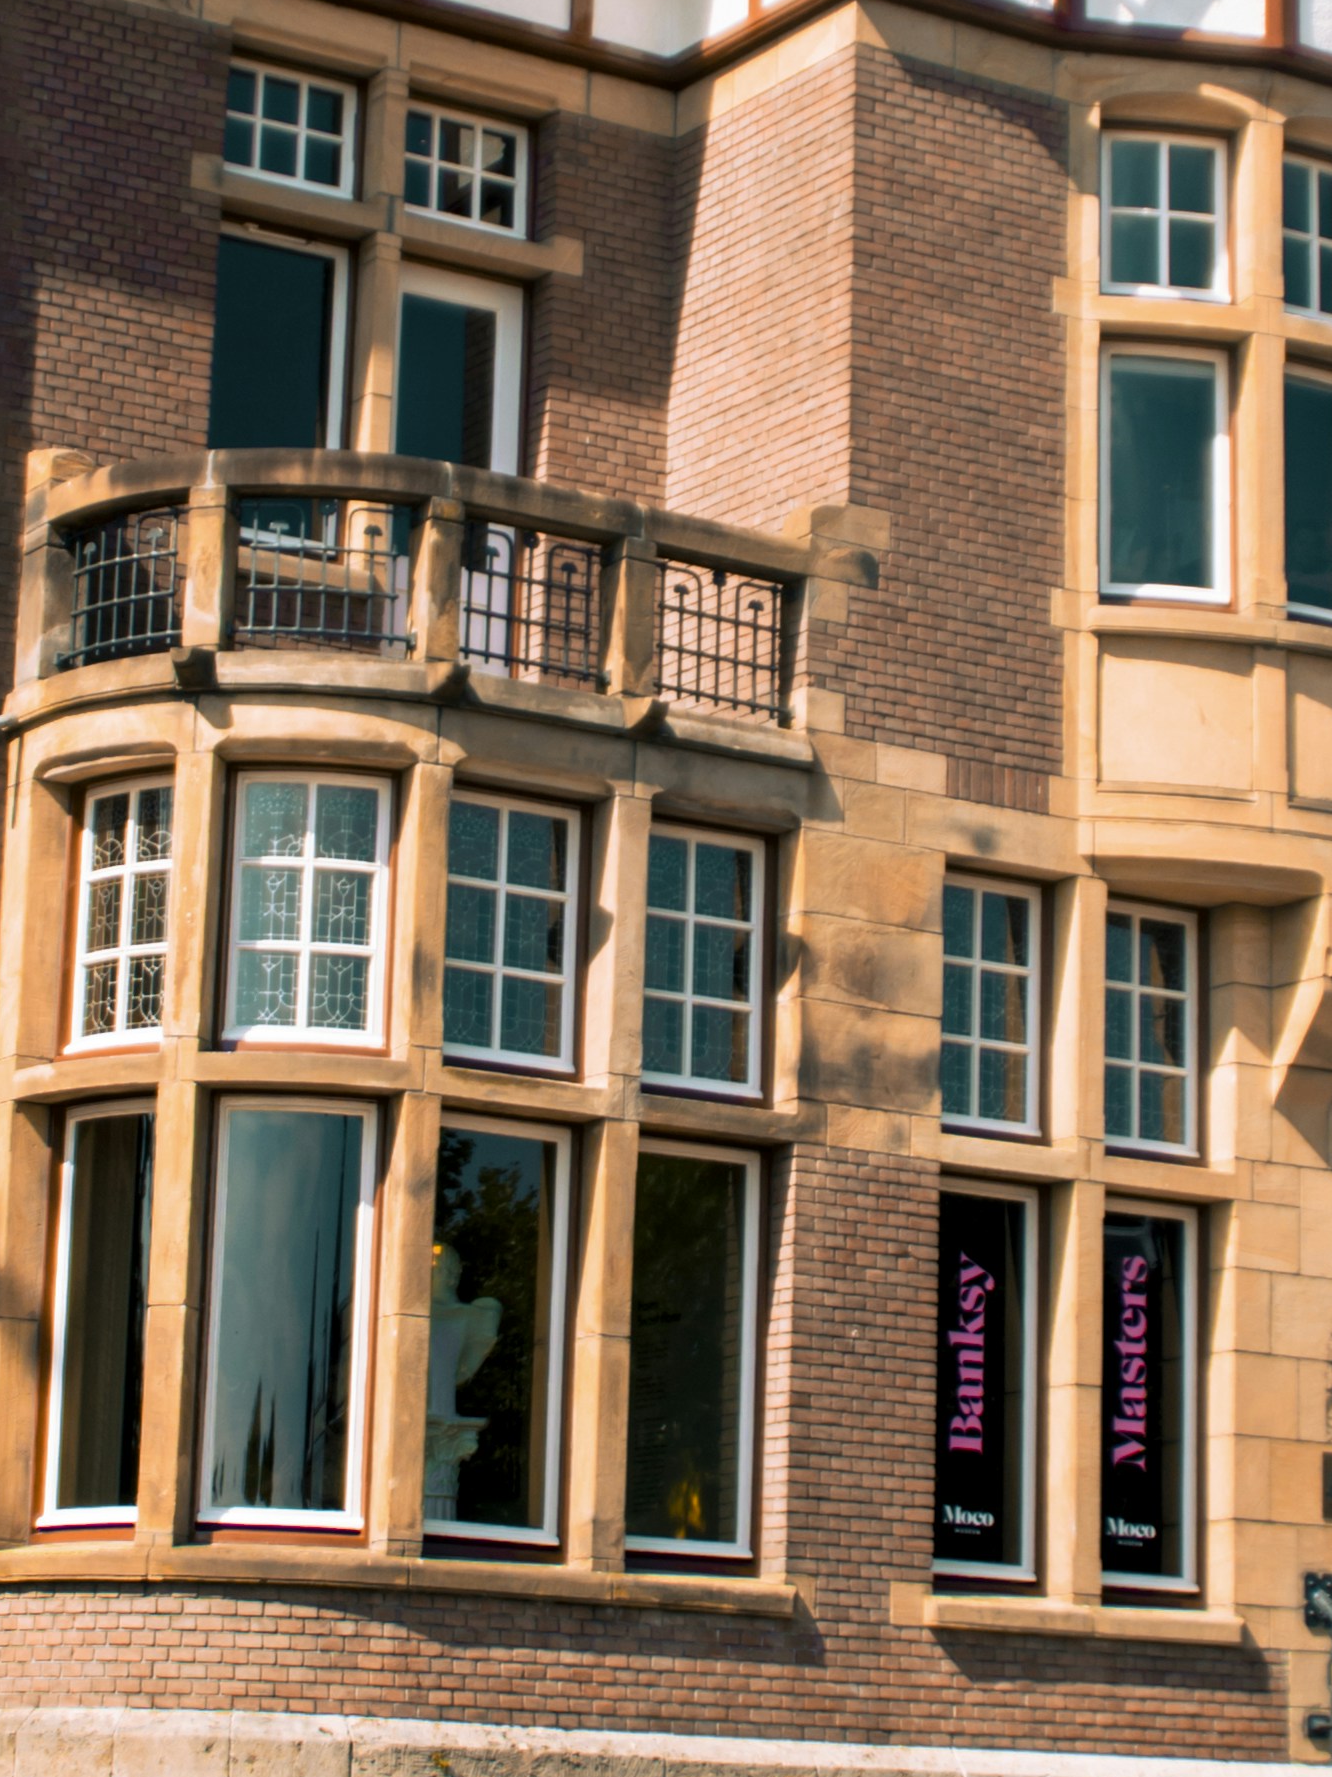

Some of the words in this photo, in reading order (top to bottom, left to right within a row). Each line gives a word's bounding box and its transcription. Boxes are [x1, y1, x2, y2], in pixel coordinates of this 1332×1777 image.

[947, 1250, 995, 1455] Banksy
[1111, 1254, 1150, 1473] Masters
[943, 1504, 995, 1527] Moco
[1106, 1516, 1157, 1540] Moco
